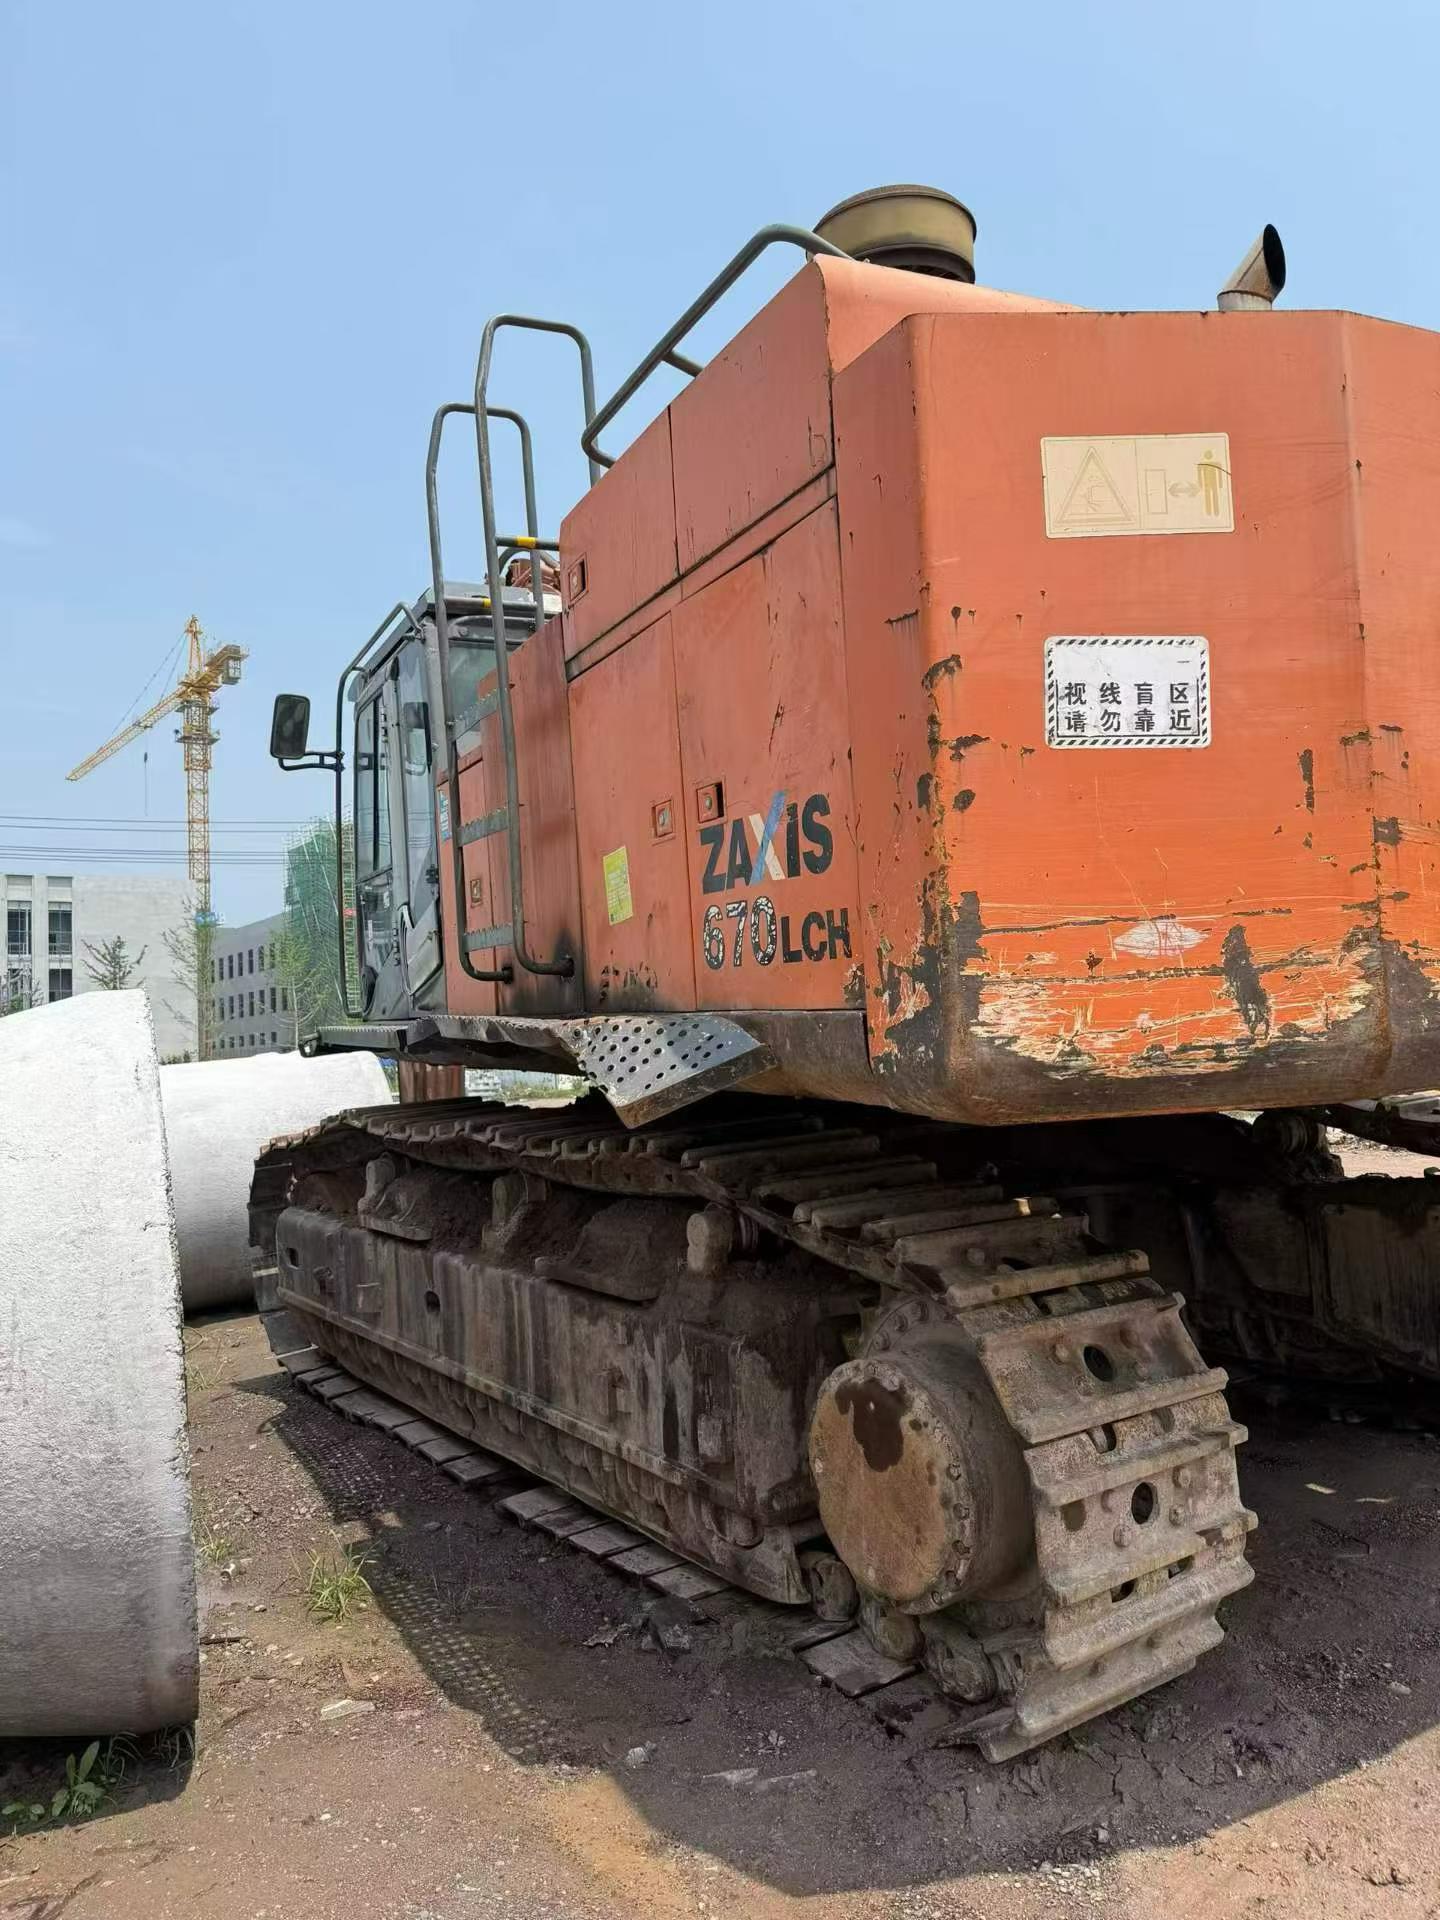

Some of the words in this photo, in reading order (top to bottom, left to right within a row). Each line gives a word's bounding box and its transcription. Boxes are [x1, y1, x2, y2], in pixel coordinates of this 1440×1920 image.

[1064, 682, 1189, 705] 视线盲区
[1064, 708, 1192, 733] 请勿靠近
[700, 790, 834, 894] ZAXIS
